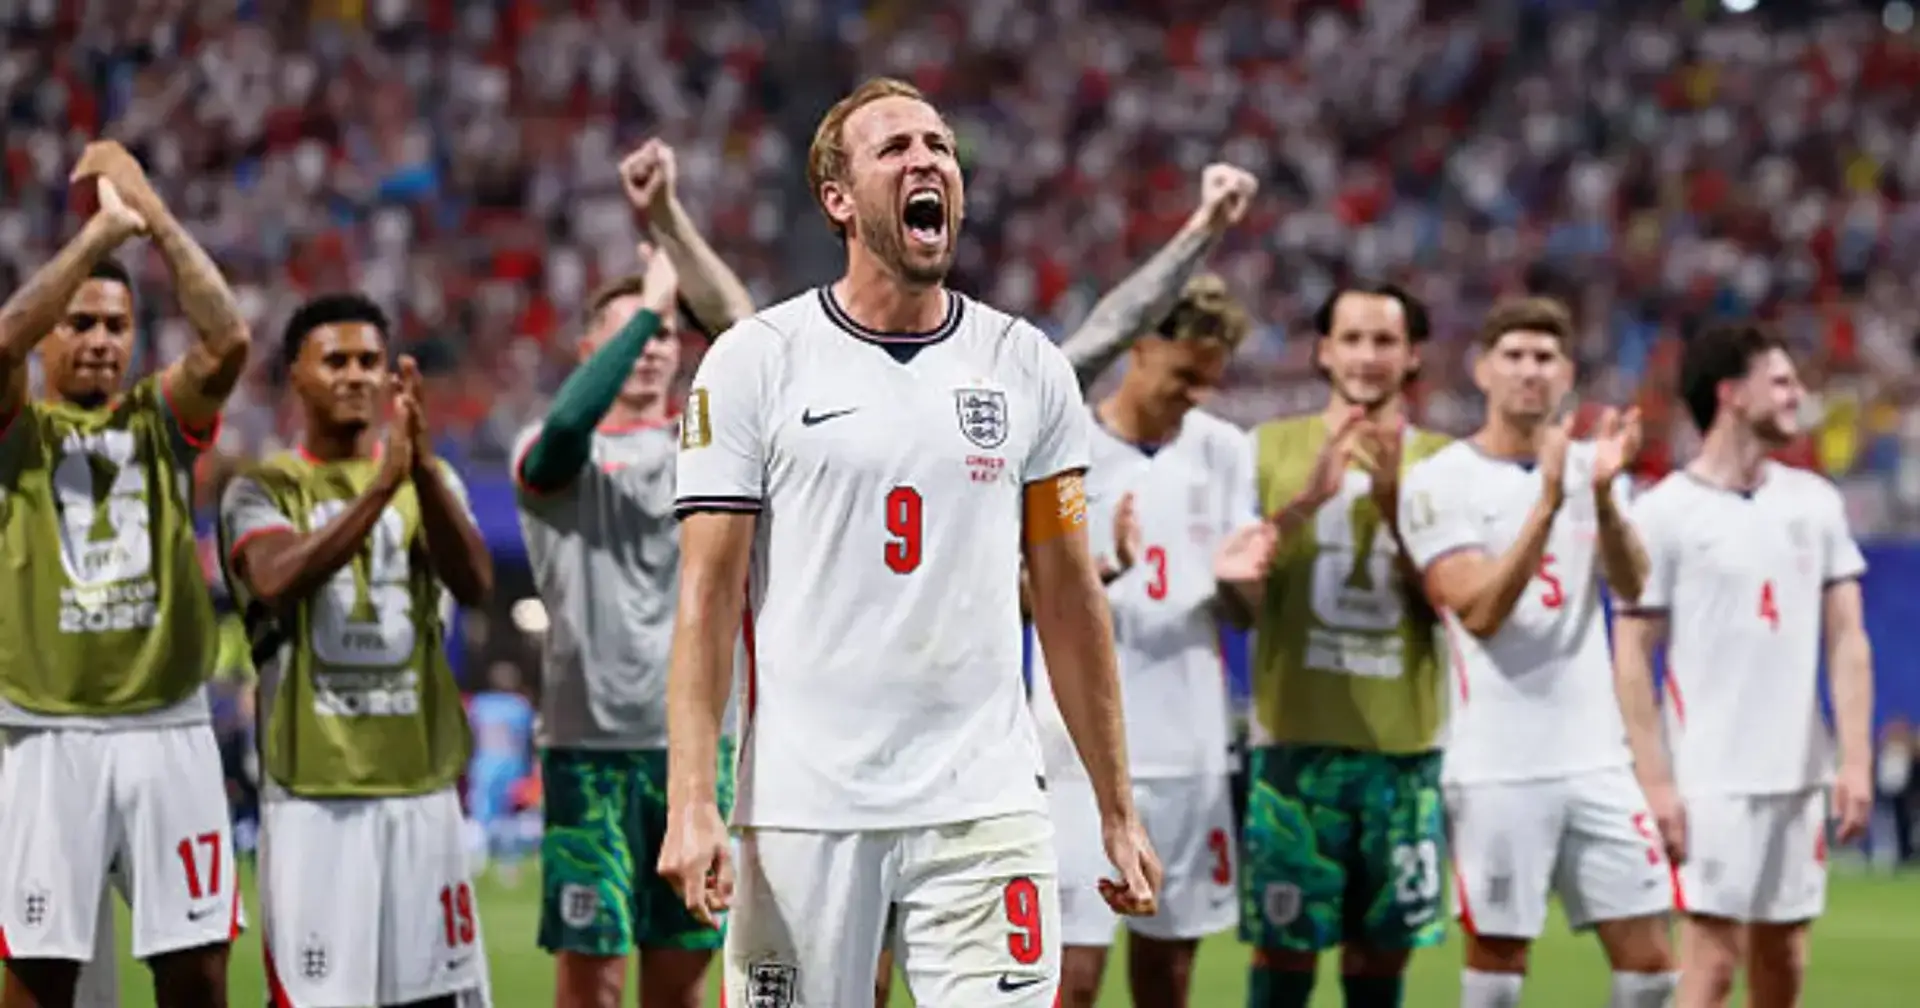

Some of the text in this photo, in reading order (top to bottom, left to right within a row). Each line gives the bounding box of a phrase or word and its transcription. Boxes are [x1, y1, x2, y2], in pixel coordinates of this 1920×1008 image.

[884, 486, 923, 575] 9
[1145, 545, 1168, 601] 3
[1540, 553, 1564, 609] 5
[1757, 578, 1779, 633] 4
[177, 830, 221, 900] 17
[1208, 827, 1231, 886] 3
[1393, 839, 1439, 903] 23
[440, 880, 476, 949] 19
[1004, 876, 1043, 965] 9
